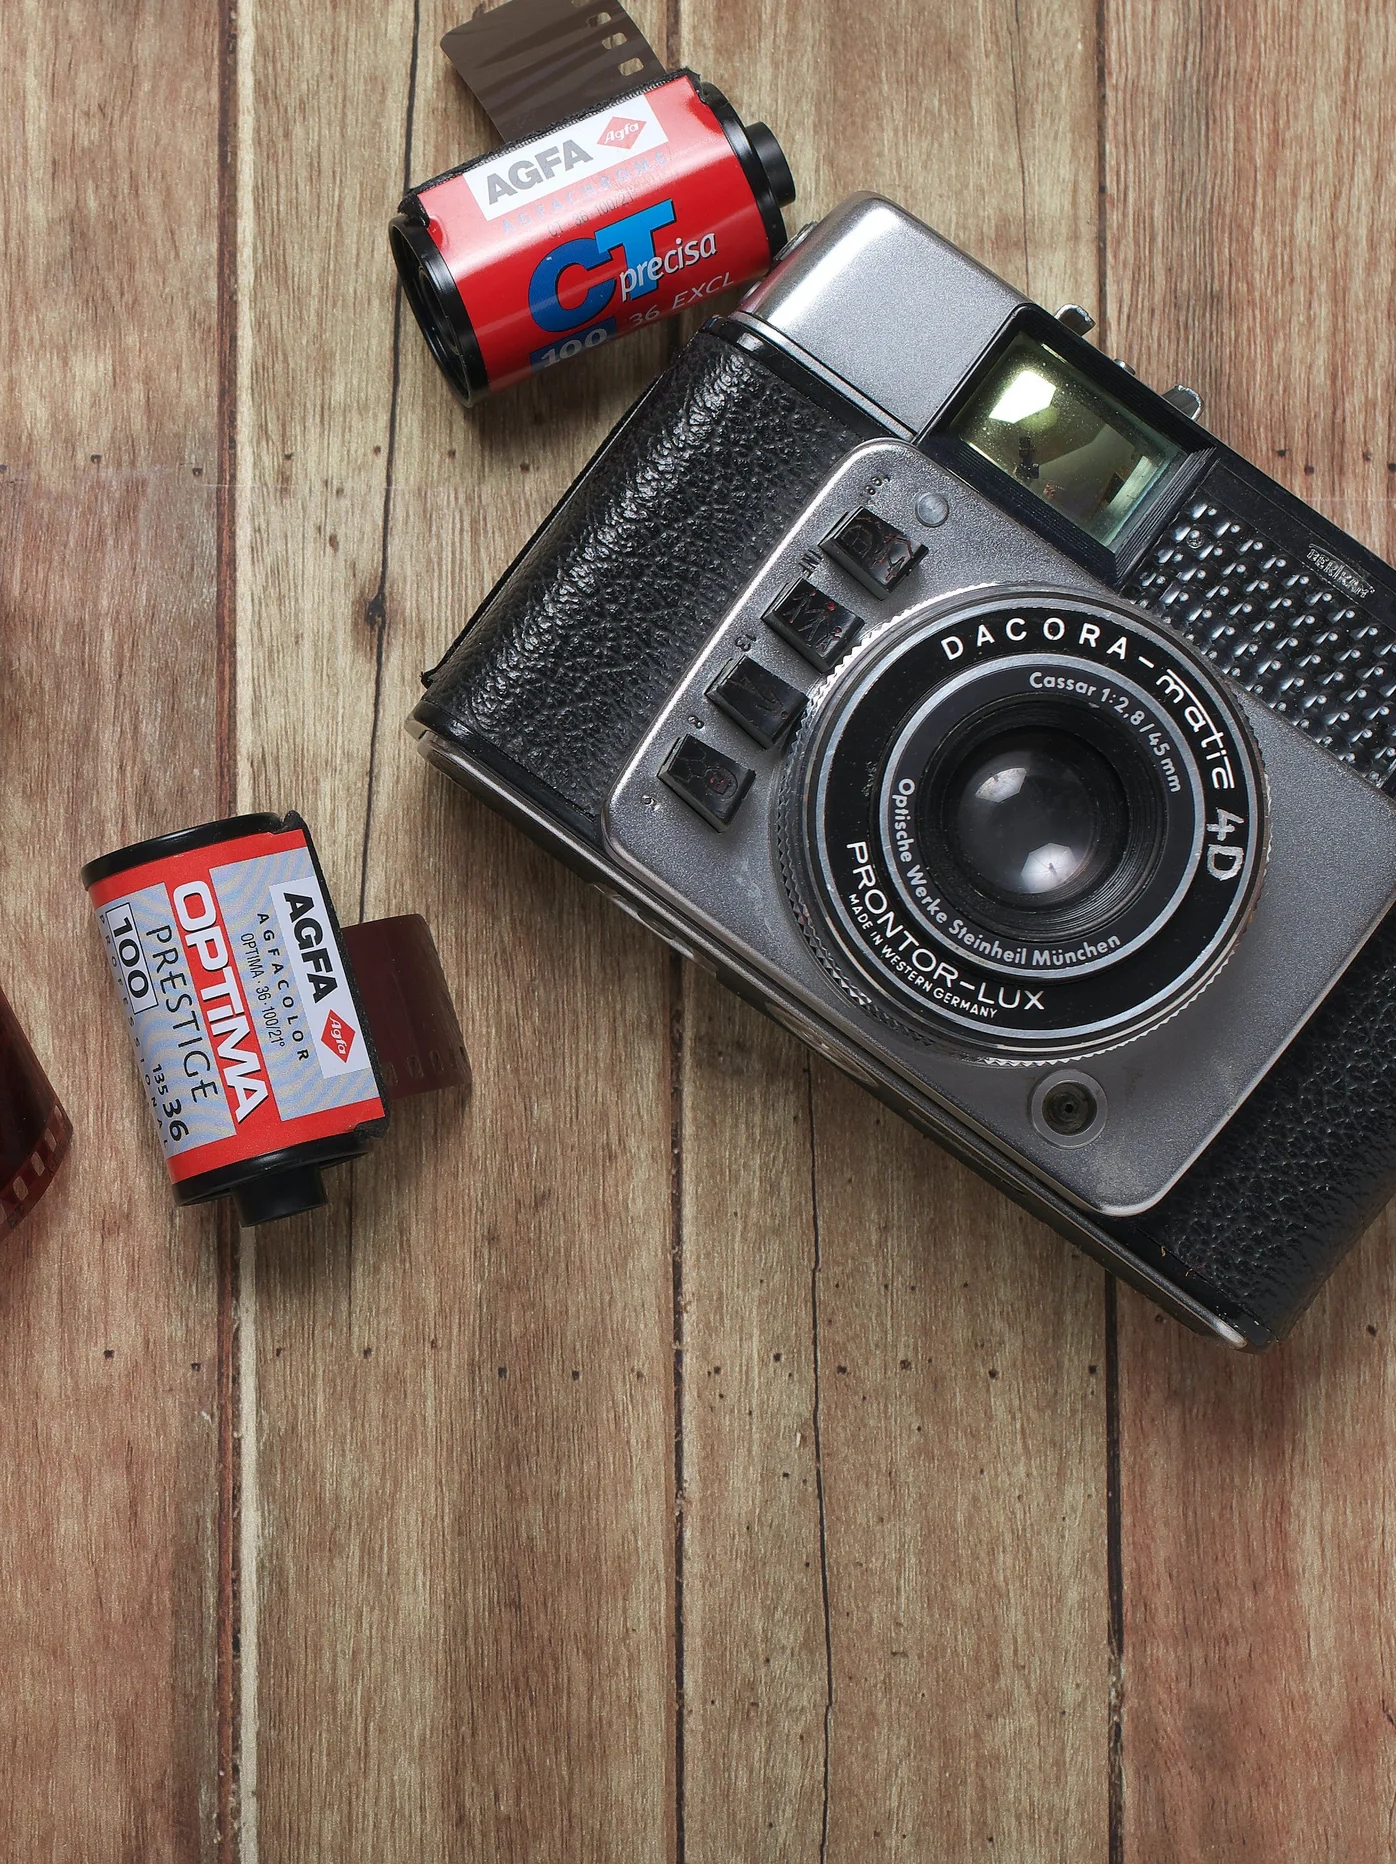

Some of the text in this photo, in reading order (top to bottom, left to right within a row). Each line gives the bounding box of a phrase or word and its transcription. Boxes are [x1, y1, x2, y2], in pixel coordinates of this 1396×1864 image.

[487, 138, 594, 206] AGFA
[604, 122, 640, 144] Agfa
[501, 150, 669, 234] AGFACHROME
[527, 198, 677, 333] CT
[619, 232, 718, 303] precisa
[629, 271, 734, 327] 36 EXCL
[540, 328, 608, 369] 100
[1029, 671, 1097, 697] Cassar
[892, 779, 1121, 966] Optische Werke Steinheil München
[112, 916, 149, 999] 100
[283, 892, 338, 1004] AGFA
[846, 841, 1044, 1010] PRONTOR-LUX
[848, 894, 997, 1019] MADE IN WESTERN GERMANY
[240, 932, 265, 979] OPTIMA
[256, 985, 272, 1001] 36
[256, 912, 309, 1061] AGFACOLOR
[146, 924, 219, 1104] PRESTIGE
[329, 1016, 347, 1055] Agfa
[152, 1063, 190, 1142] 135 36
